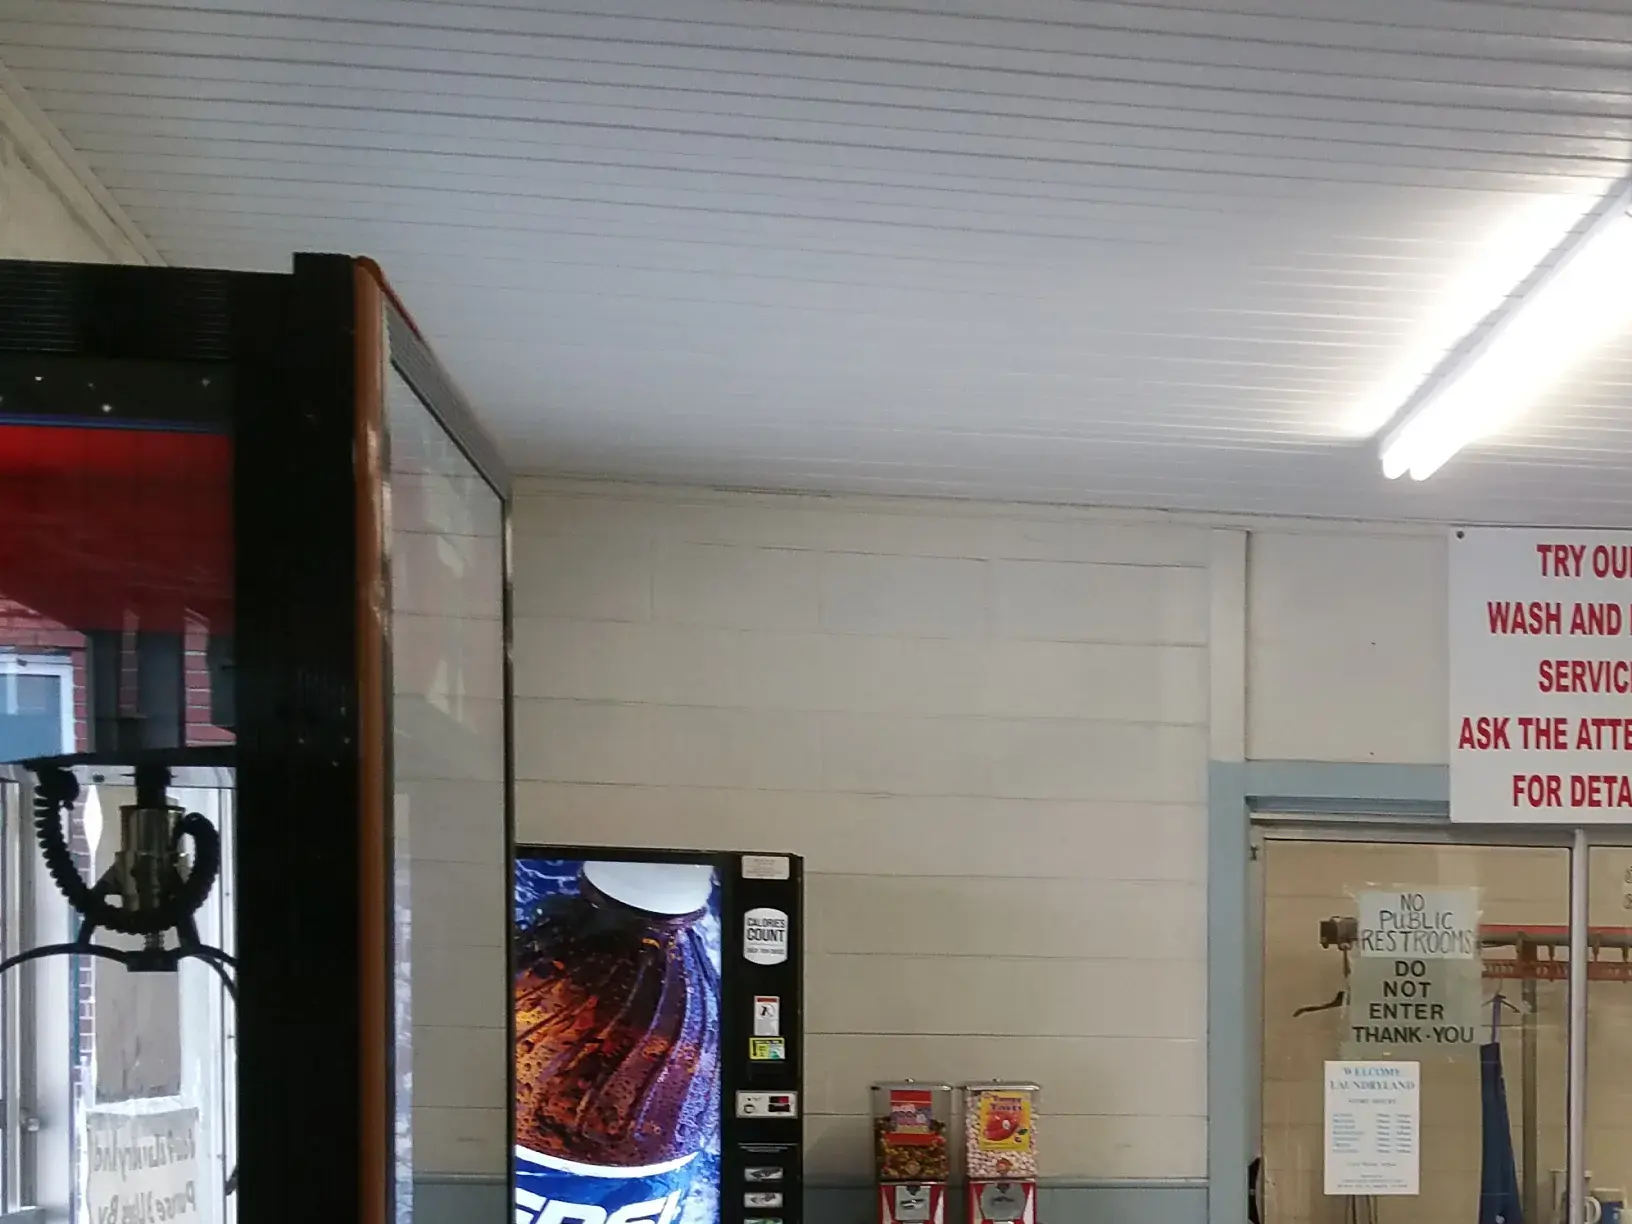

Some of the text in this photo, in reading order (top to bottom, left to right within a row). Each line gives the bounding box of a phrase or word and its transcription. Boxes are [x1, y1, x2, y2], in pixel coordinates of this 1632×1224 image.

[1536, 544, 1586, 577] TRY
[1487, 601, 1562, 635] WASH
[1570, 603, 1622, 635] AND
[1458, 717, 1511, 750] ASK
[1519, 717, 1568, 750] THE
[1513, 775, 1562, 807] FOR
[1400, 893, 1425, 912] NO
[747, 918, 785, 928] CALORIES
[1379, 910, 1455, 930] PUBLIC
[747, 928, 786, 941] COUNT
[1361, 929, 1474, 955] RESTROOMS
[1395, 960, 1426, 977] DO
[1383, 980, 1431, 998] NOT
[1369, 1003, 1444, 1020] ENTER
[1344, 1067, 1400, 1077] WELCOME
[1330, 1080, 1415, 1091] LAUNDRYLAND
